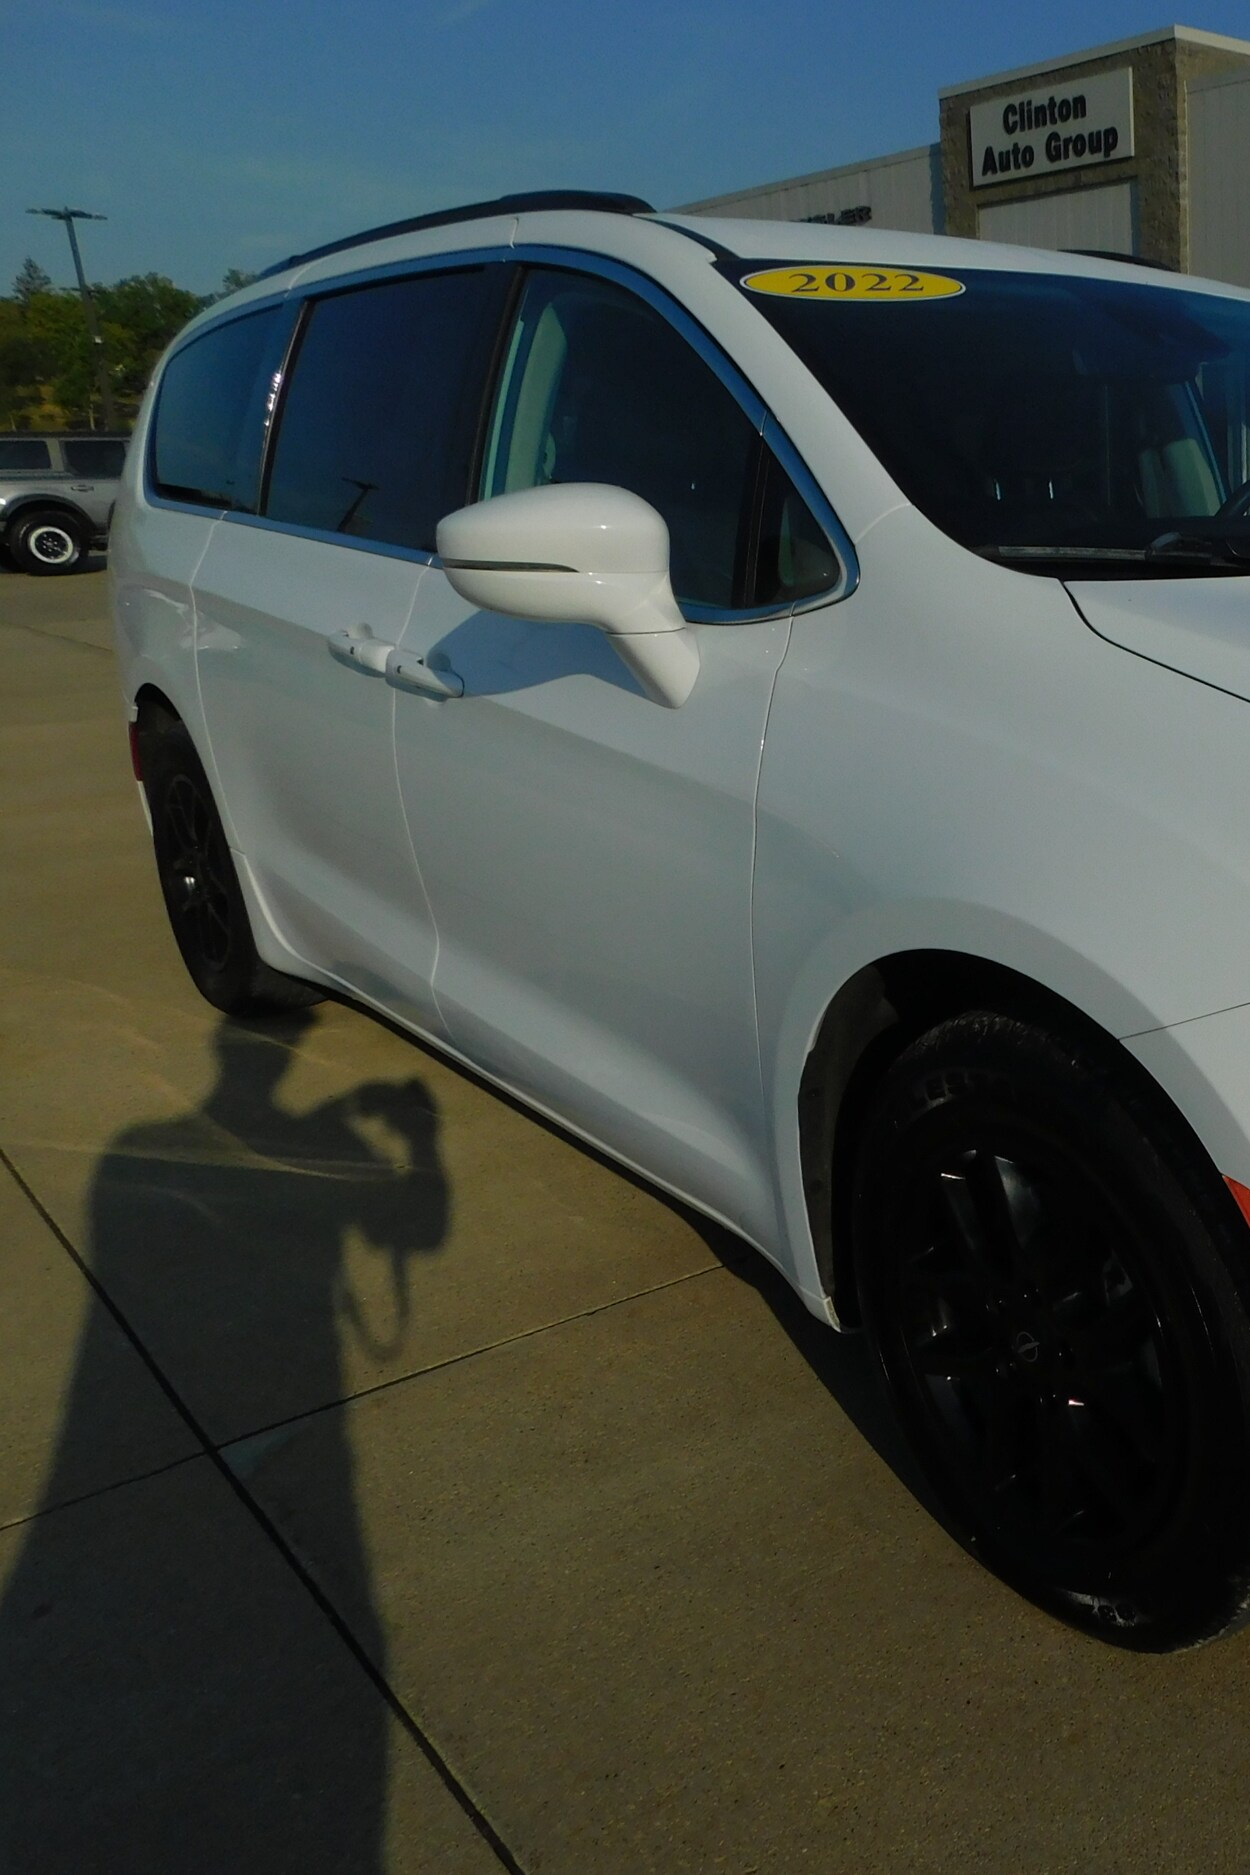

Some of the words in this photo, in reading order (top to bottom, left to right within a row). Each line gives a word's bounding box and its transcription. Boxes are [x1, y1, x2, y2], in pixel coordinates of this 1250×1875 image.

[1003, 94, 1087, 135] Clinton
[981, 142, 1035, 176] Auto
[1045, 126, 1119, 163] Group
[788, 271, 925, 293] 2022
